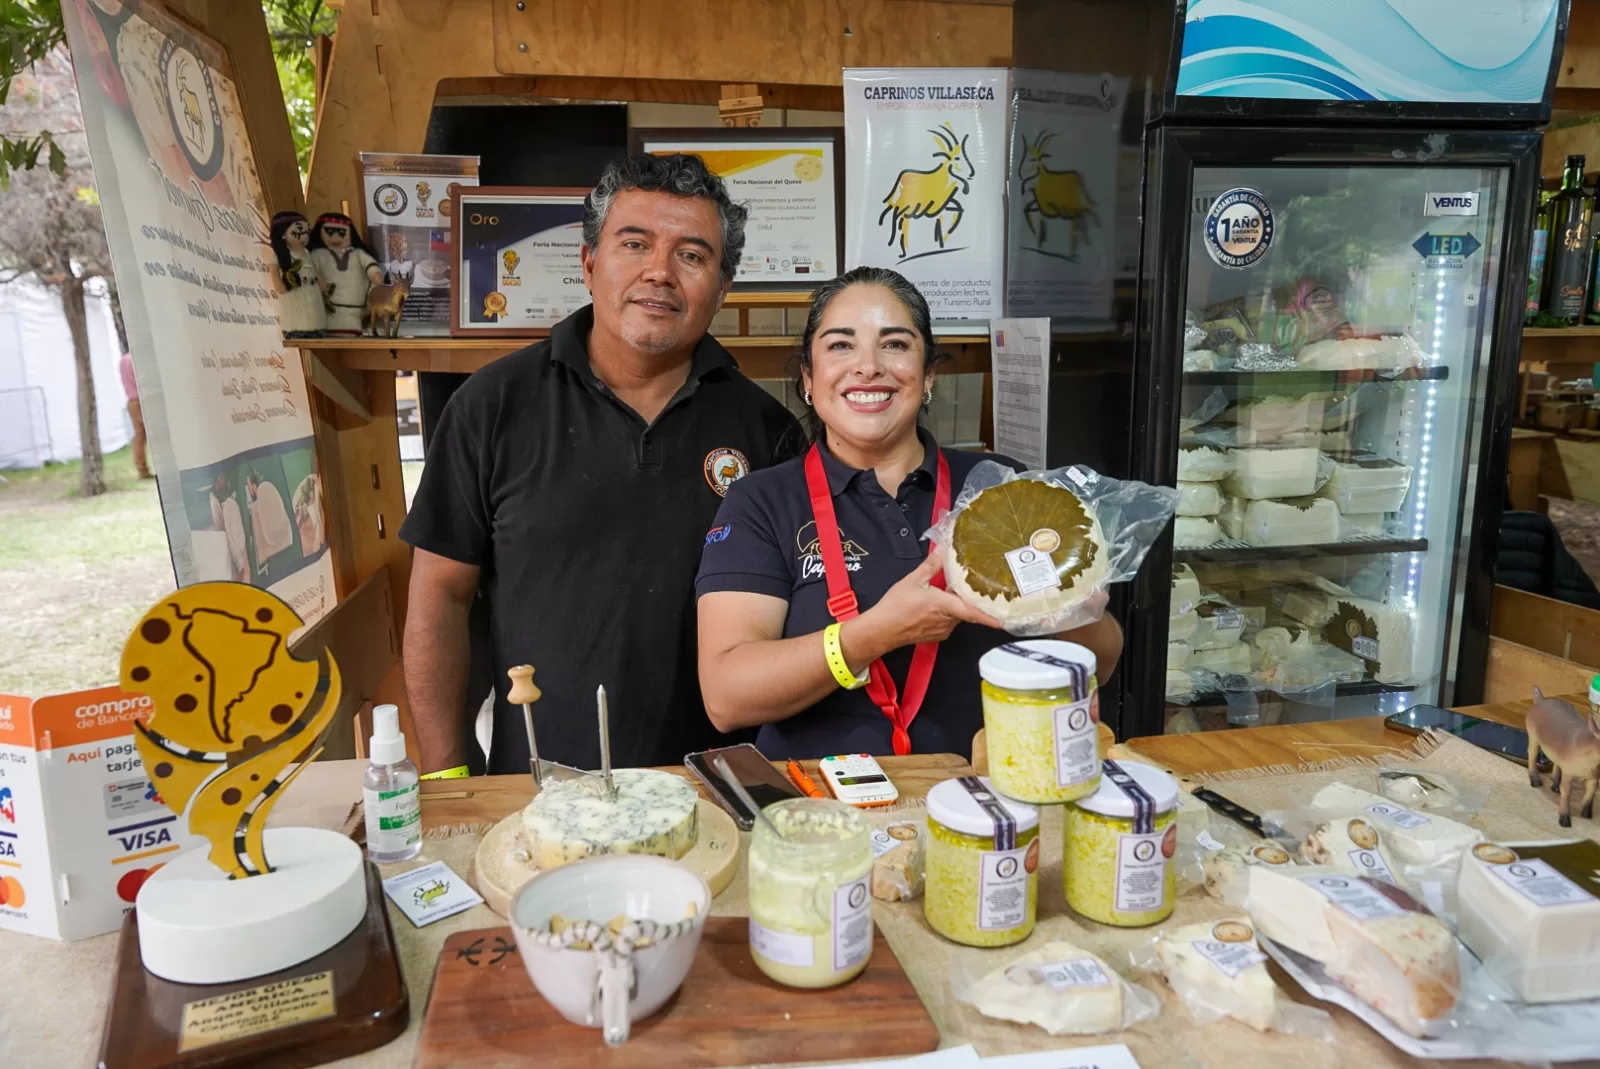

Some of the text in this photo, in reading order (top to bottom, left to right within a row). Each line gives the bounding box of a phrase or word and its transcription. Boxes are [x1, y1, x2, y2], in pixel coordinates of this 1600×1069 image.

[864, 86, 925, 100] CAPRINOS
[927, 86, 995, 101] VILLASECA
[1213, 194, 1239, 217] GARANTÍA
[1248, 195, 1270, 217] CALIDAD
[1433, 197, 1472, 209] VENTUS
[469, 213, 500, 225] Oro
[1221, 216, 1260, 243] 1 AÑO
[1245, 243, 1267, 264] CALIDAD
[1432, 237, 1463, 254] LED
[952, 279, 991, 288] productos
[923, 289, 962, 298] producción
[973, 298, 991, 306] Rural
[75, 695, 153, 718] compra
[77, 709, 154, 728] de BancoEs
[10, 753, 27, 764] tus
[66, 747, 102, 764] Aquí
[106, 758, 141, 773] tarje
[118, 828, 172, 852] VISA
[0, 841, 16, 857] SA
[192, 974, 326, 1009] MEJOR QUESO
[214, 987, 305, 1014] AMERICA
